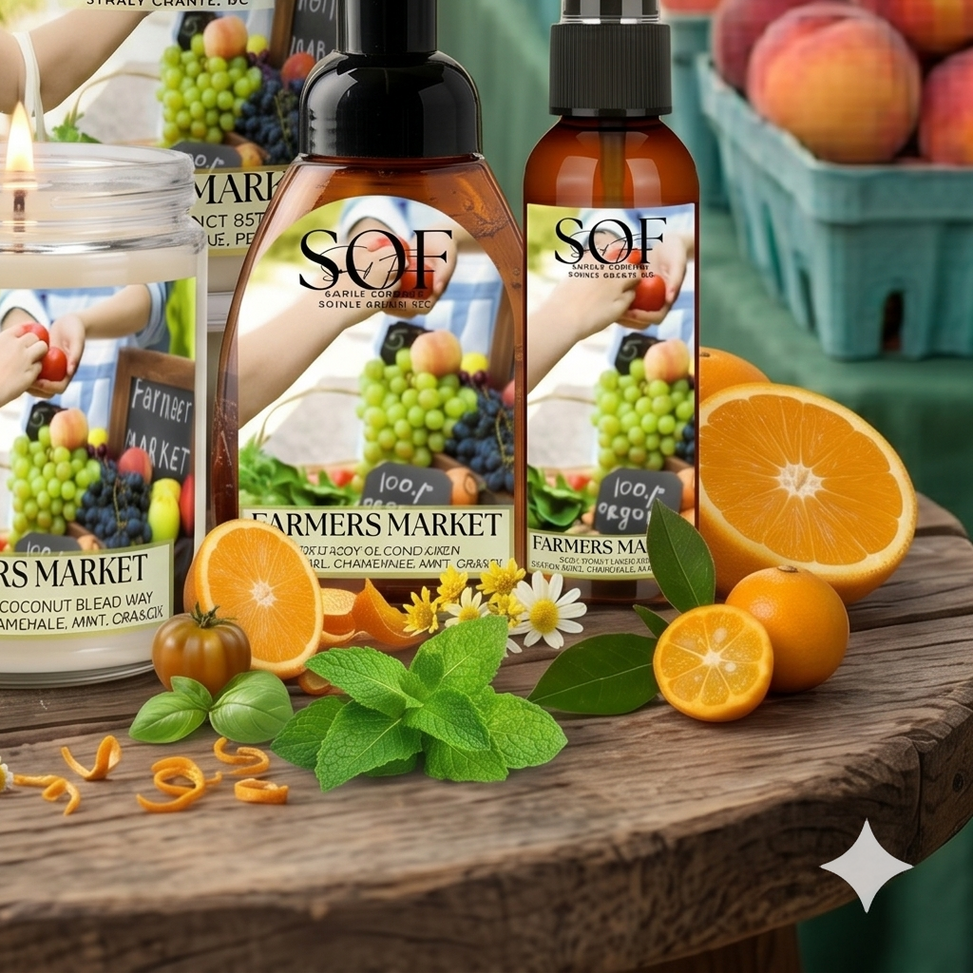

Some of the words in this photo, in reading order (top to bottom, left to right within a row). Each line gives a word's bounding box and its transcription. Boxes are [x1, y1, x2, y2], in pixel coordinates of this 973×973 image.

[194, 171, 286, 205] MARK
[555, 216, 667, 265] SOF
[298, 229, 453, 291] SOF
[387, 512, 503, 537] MARKET
[532, 534, 613, 555] FARMERS
[617, 539, 648, 555] MA
[35, 553, 149, 588] MARKET
[76, 595, 122, 612] BLEAD
[125, 590, 154, 607] WAY
